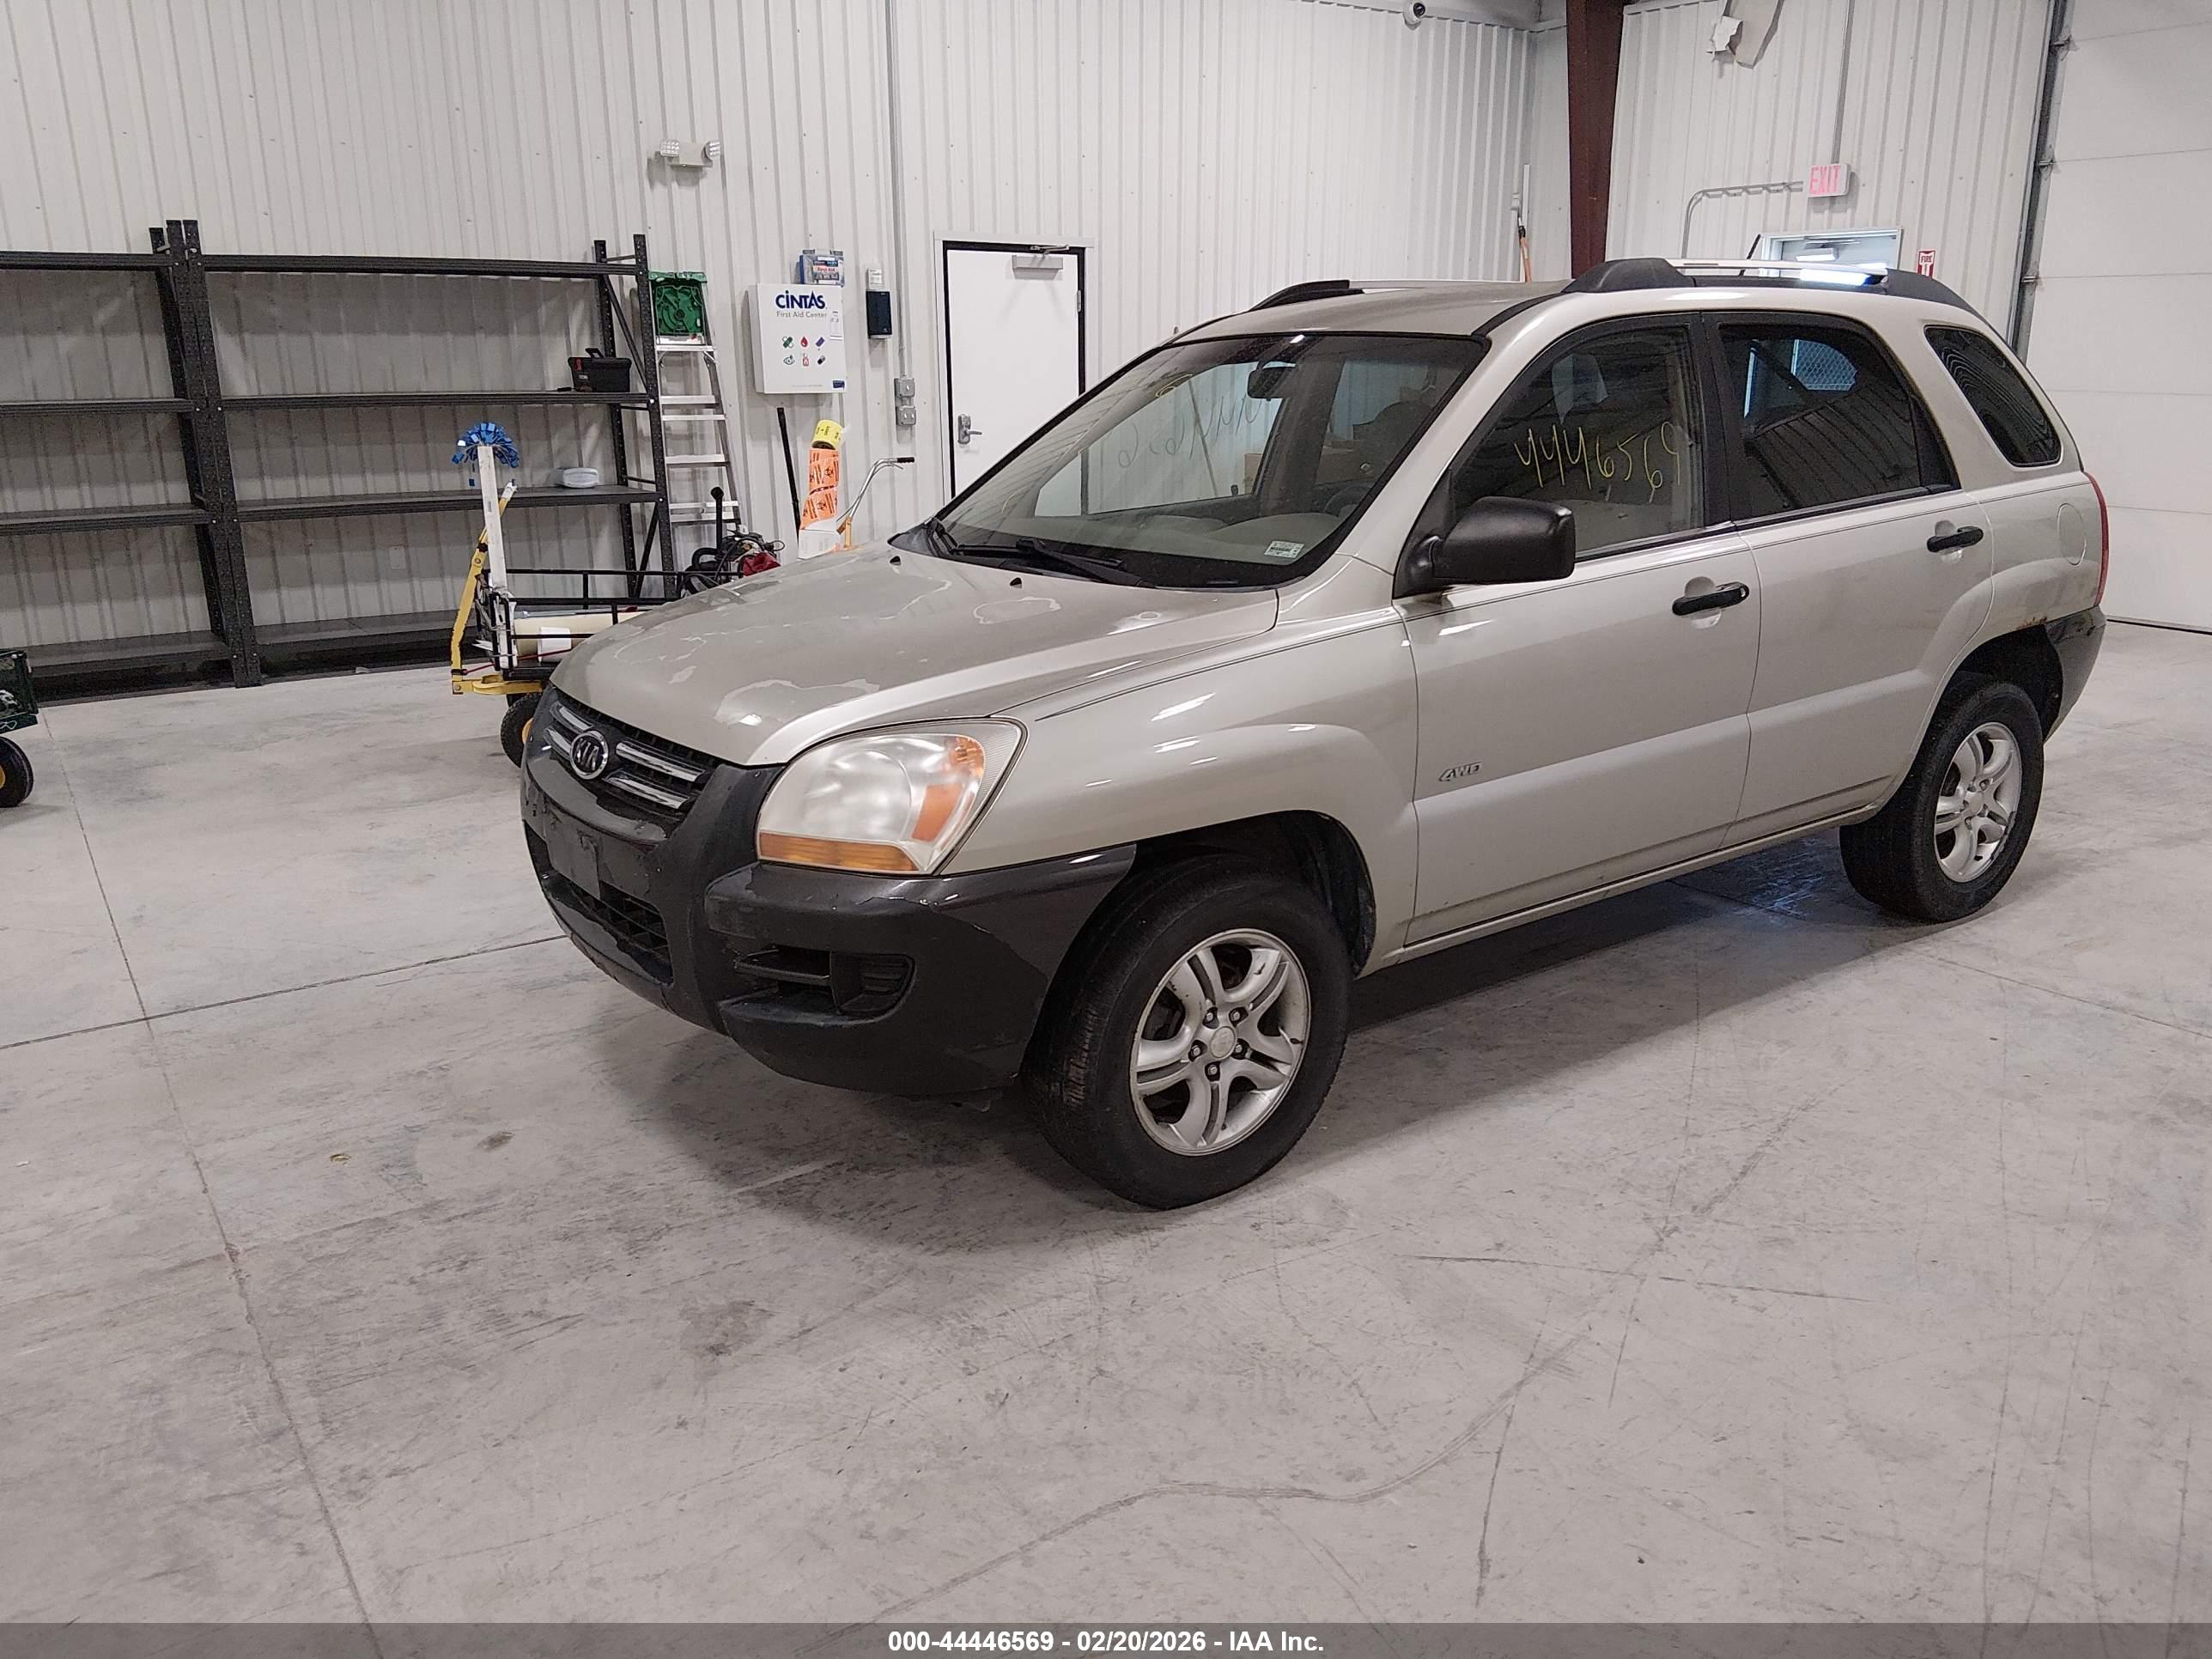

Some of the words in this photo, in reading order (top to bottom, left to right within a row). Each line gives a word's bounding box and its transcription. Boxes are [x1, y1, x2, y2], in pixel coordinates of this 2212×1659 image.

[1809, 165, 1842, 194] EXIT
[775, 289, 826, 310] CINTAS
[1514, 421, 1680, 490] 4446569
[574, 738, 600, 771] KIA
[1438, 761, 1482, 782] 4WD
